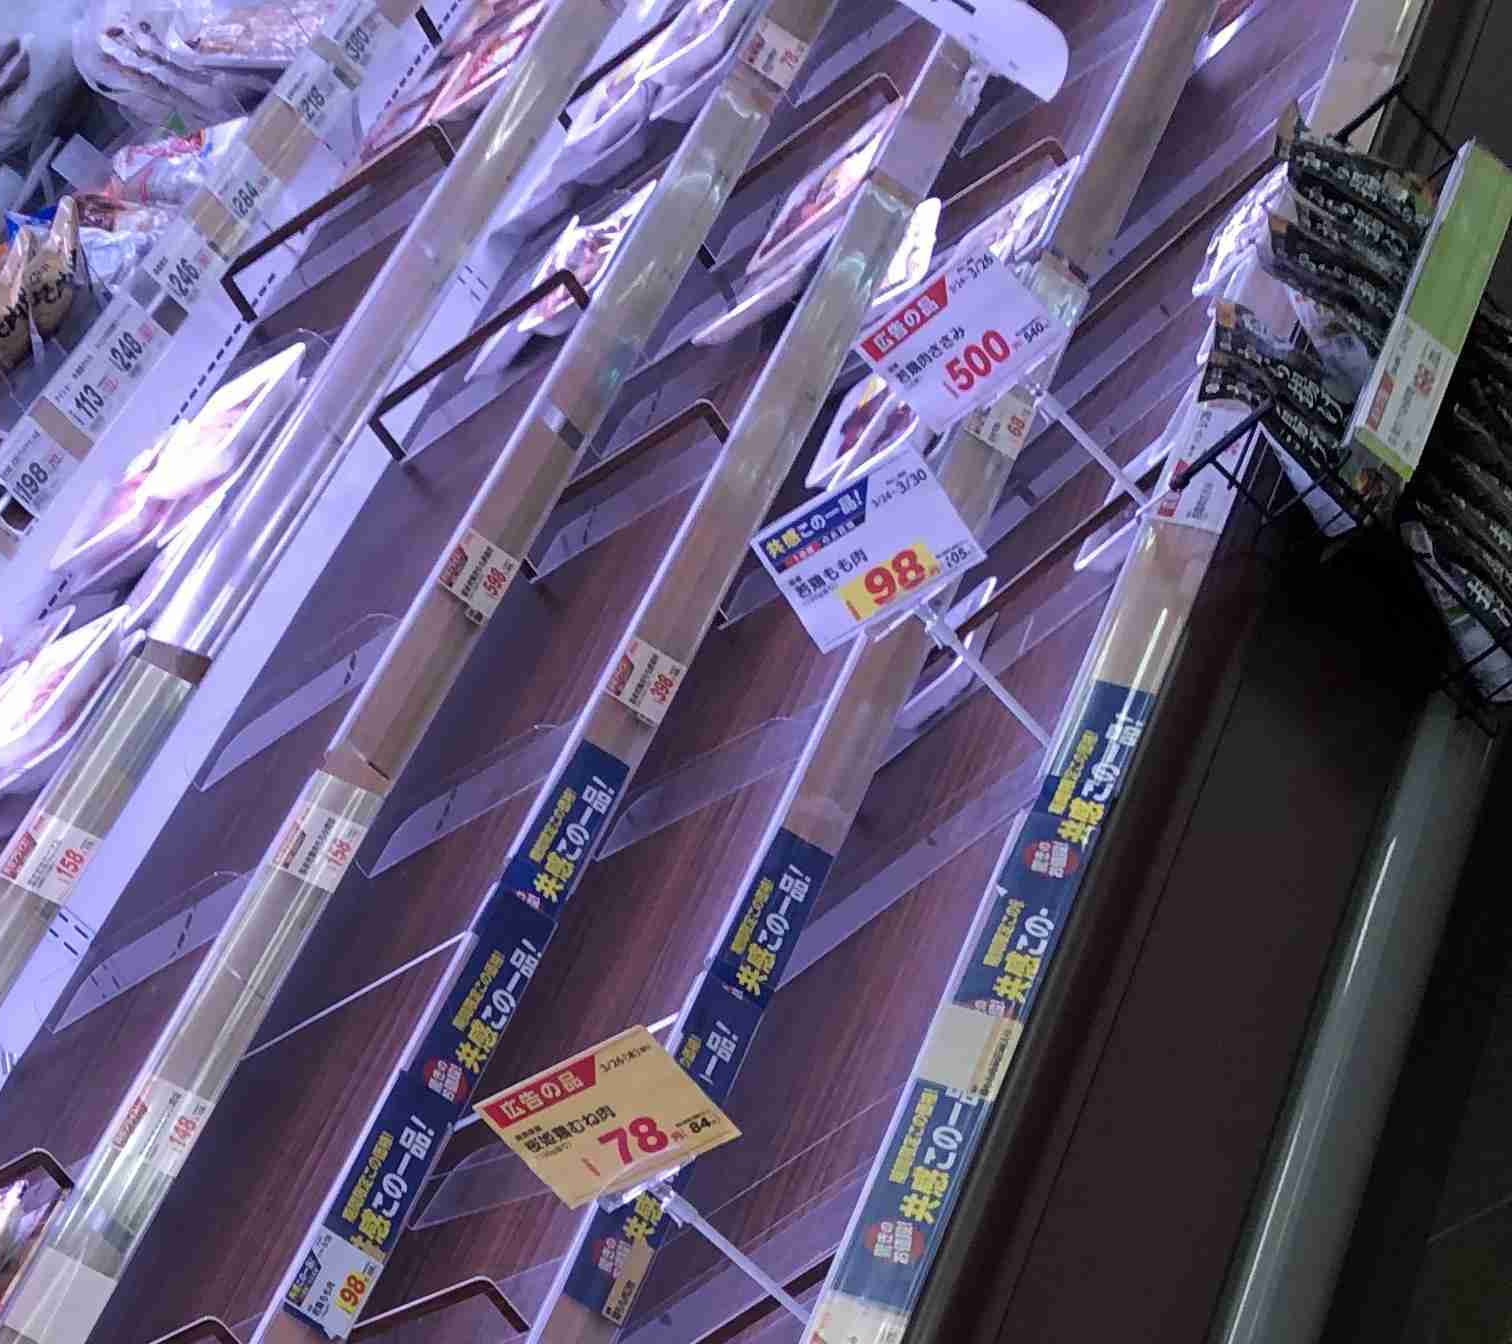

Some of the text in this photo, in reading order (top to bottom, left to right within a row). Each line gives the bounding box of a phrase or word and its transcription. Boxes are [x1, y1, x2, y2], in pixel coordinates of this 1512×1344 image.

[164, 256, 203, 296] 246
[872, 294, 941, 354] 広告の品
[943, 325, 1015, 392] 500
[70, 382, 108, 419] 113
[13, 459, 51, 499] 198
[764, 489, 867, 559] 共感この一品!
[793, 547, 869, 600] 若鶏もも肉
[859, 545, 930, 607] 98
[531, 774, 618, 902] 共感この一品!
[734, 863, 817, 994] 共感この一品!
[453, 937, 547, 1074] 共感この一品!
[499, 1068, 583, 1120] 広告の品
[596, 1110, 670, 1172] 78
[688, 1116, 712, 1134] 84
[337, 1273, 369, 1308] 98
